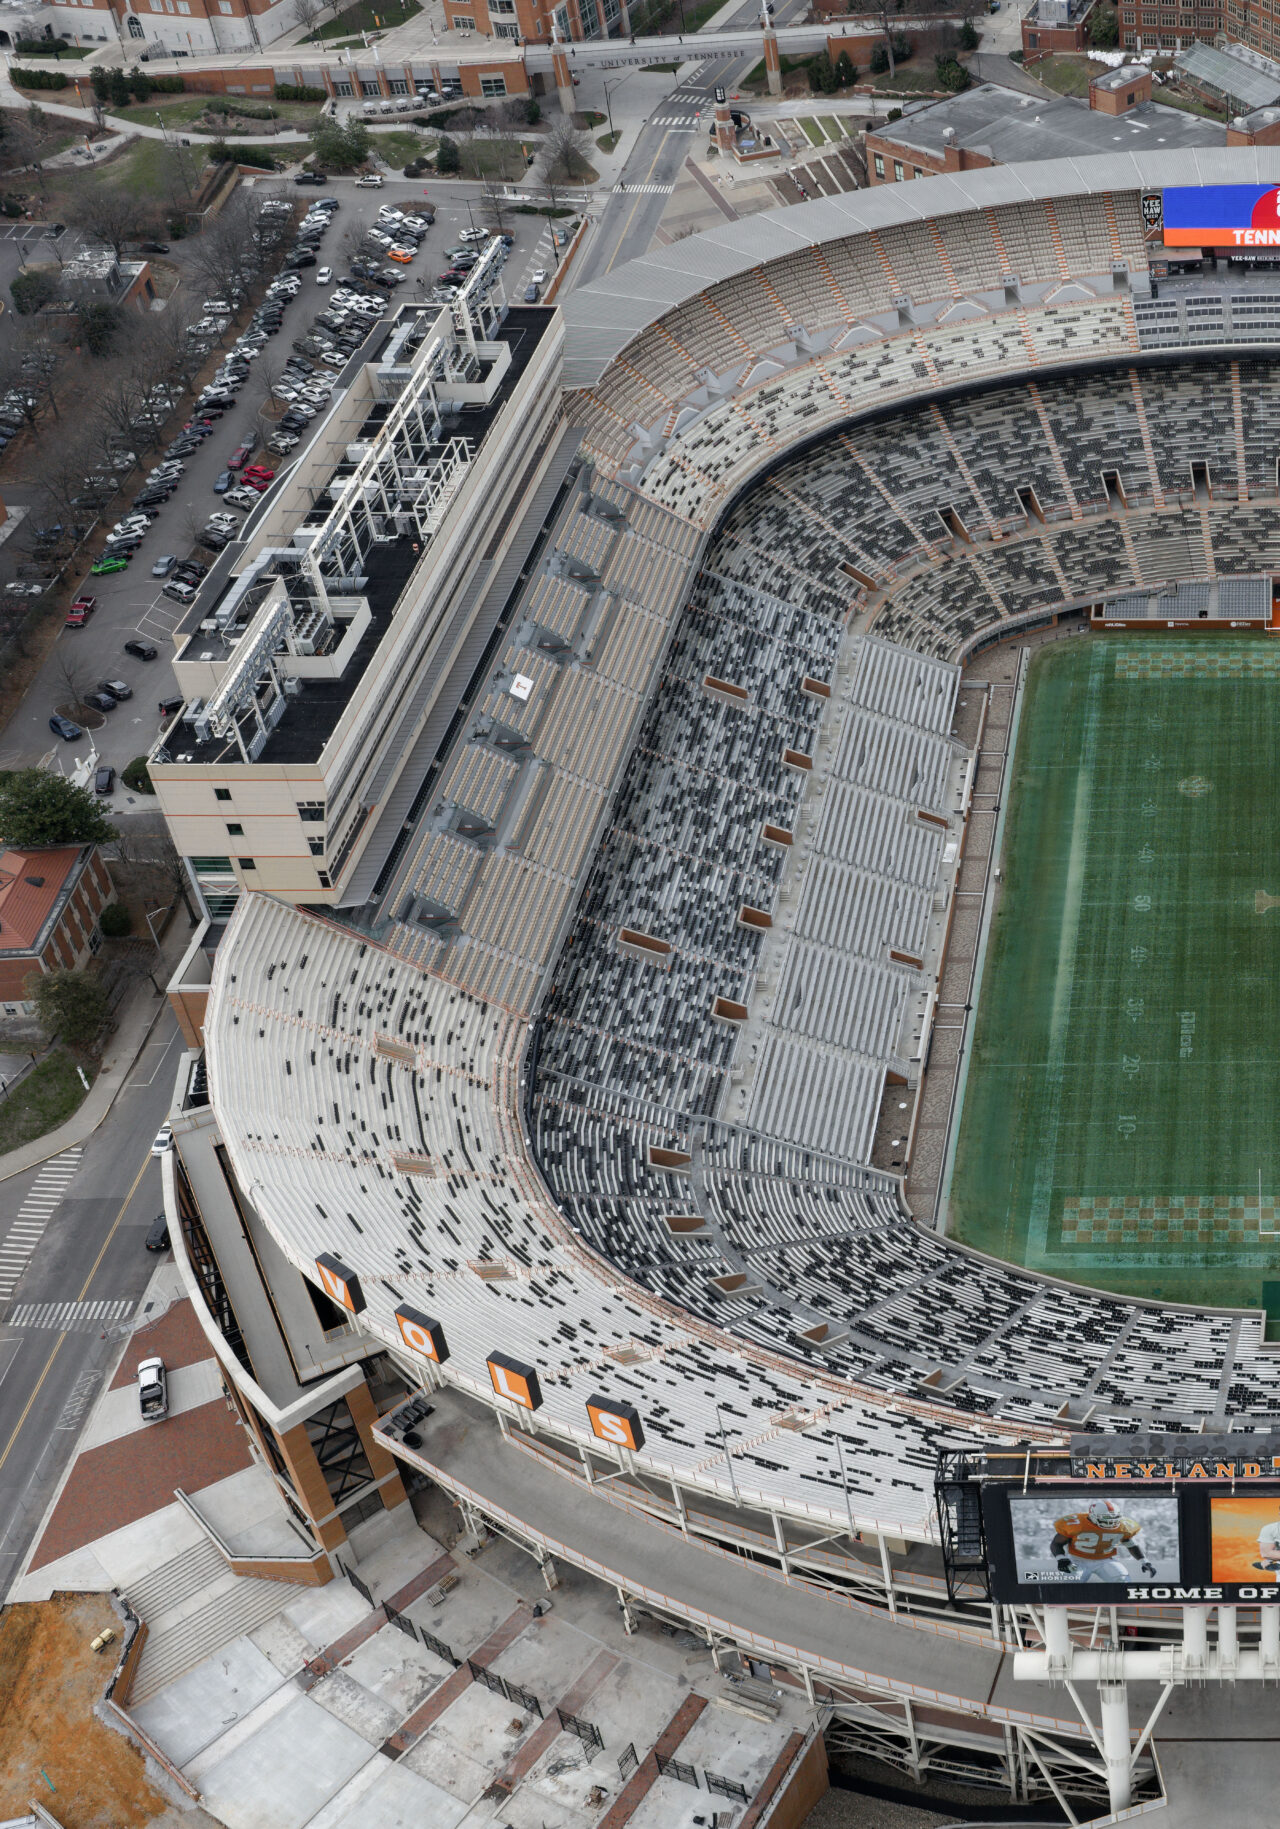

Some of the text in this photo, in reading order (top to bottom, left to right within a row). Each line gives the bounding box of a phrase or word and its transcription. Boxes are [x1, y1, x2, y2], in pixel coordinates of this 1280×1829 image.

[601, 56, 666, 67] UNIVERSITY
[688, 50, 745, 61] TENNESSEE
[1134, 895, 1151, 912] 50
[1127, 998, 1144, 1017] 30
[1122, 1054, 1141, 1073] 20
[1118, 1114, 1136, 1133] 10
[1086, 1463, 1261, 1479] NEYLAND
[1127, 1587, 1223, 1600] HOME
[1238, 1587, 1279, 1599] OF
